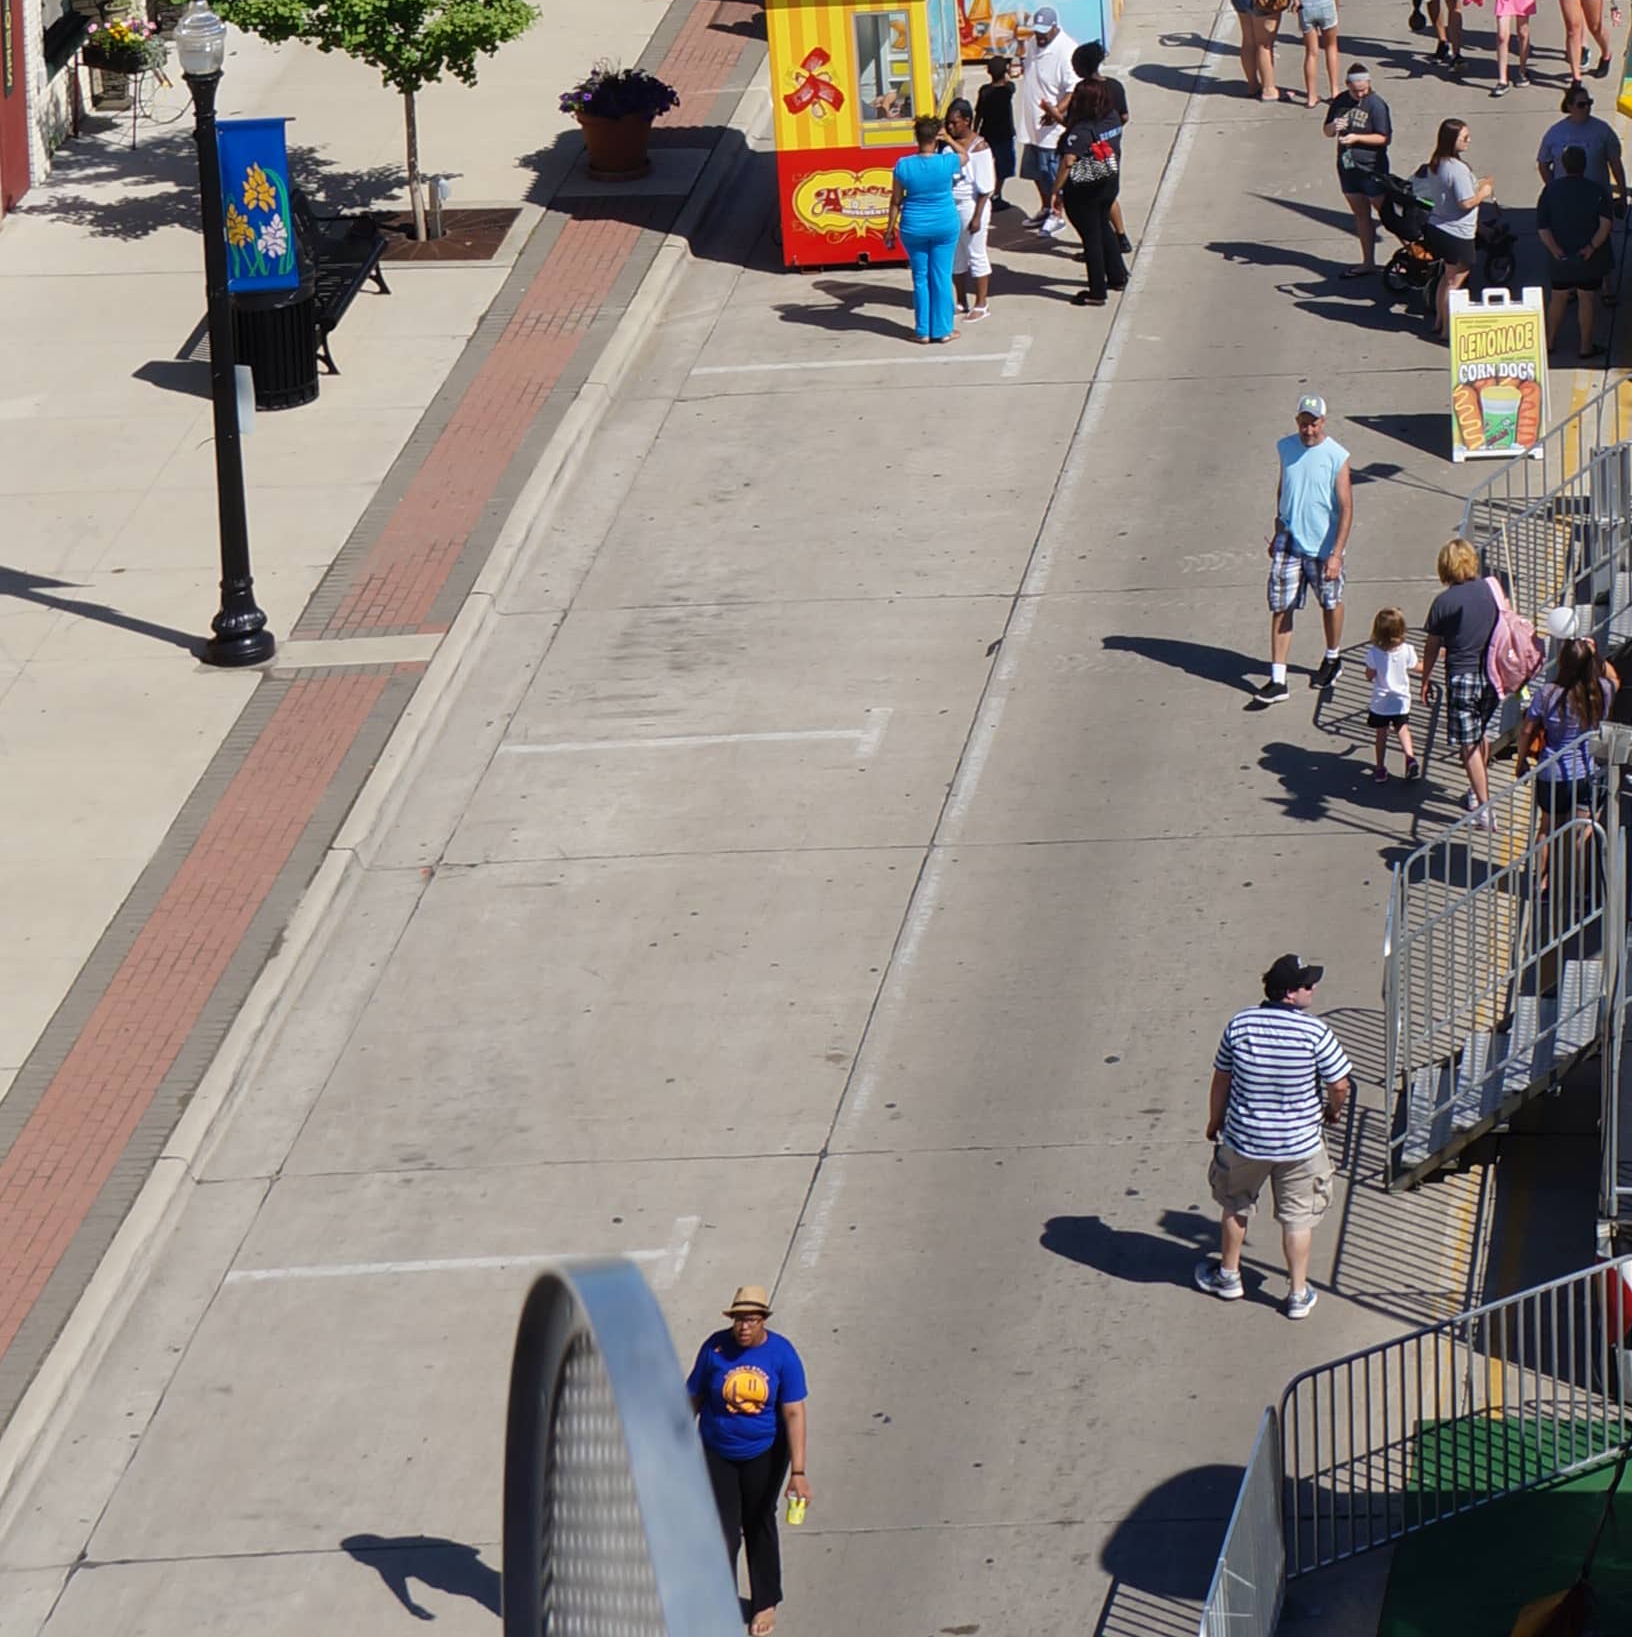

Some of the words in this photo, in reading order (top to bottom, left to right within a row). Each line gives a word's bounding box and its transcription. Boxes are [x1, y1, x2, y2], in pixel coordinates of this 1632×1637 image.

[1459, 322, 1534, 362] LEMONADE
[1459, 363, 1496, 383] CORN
[1498, 362, 1535, 382] DOGS
